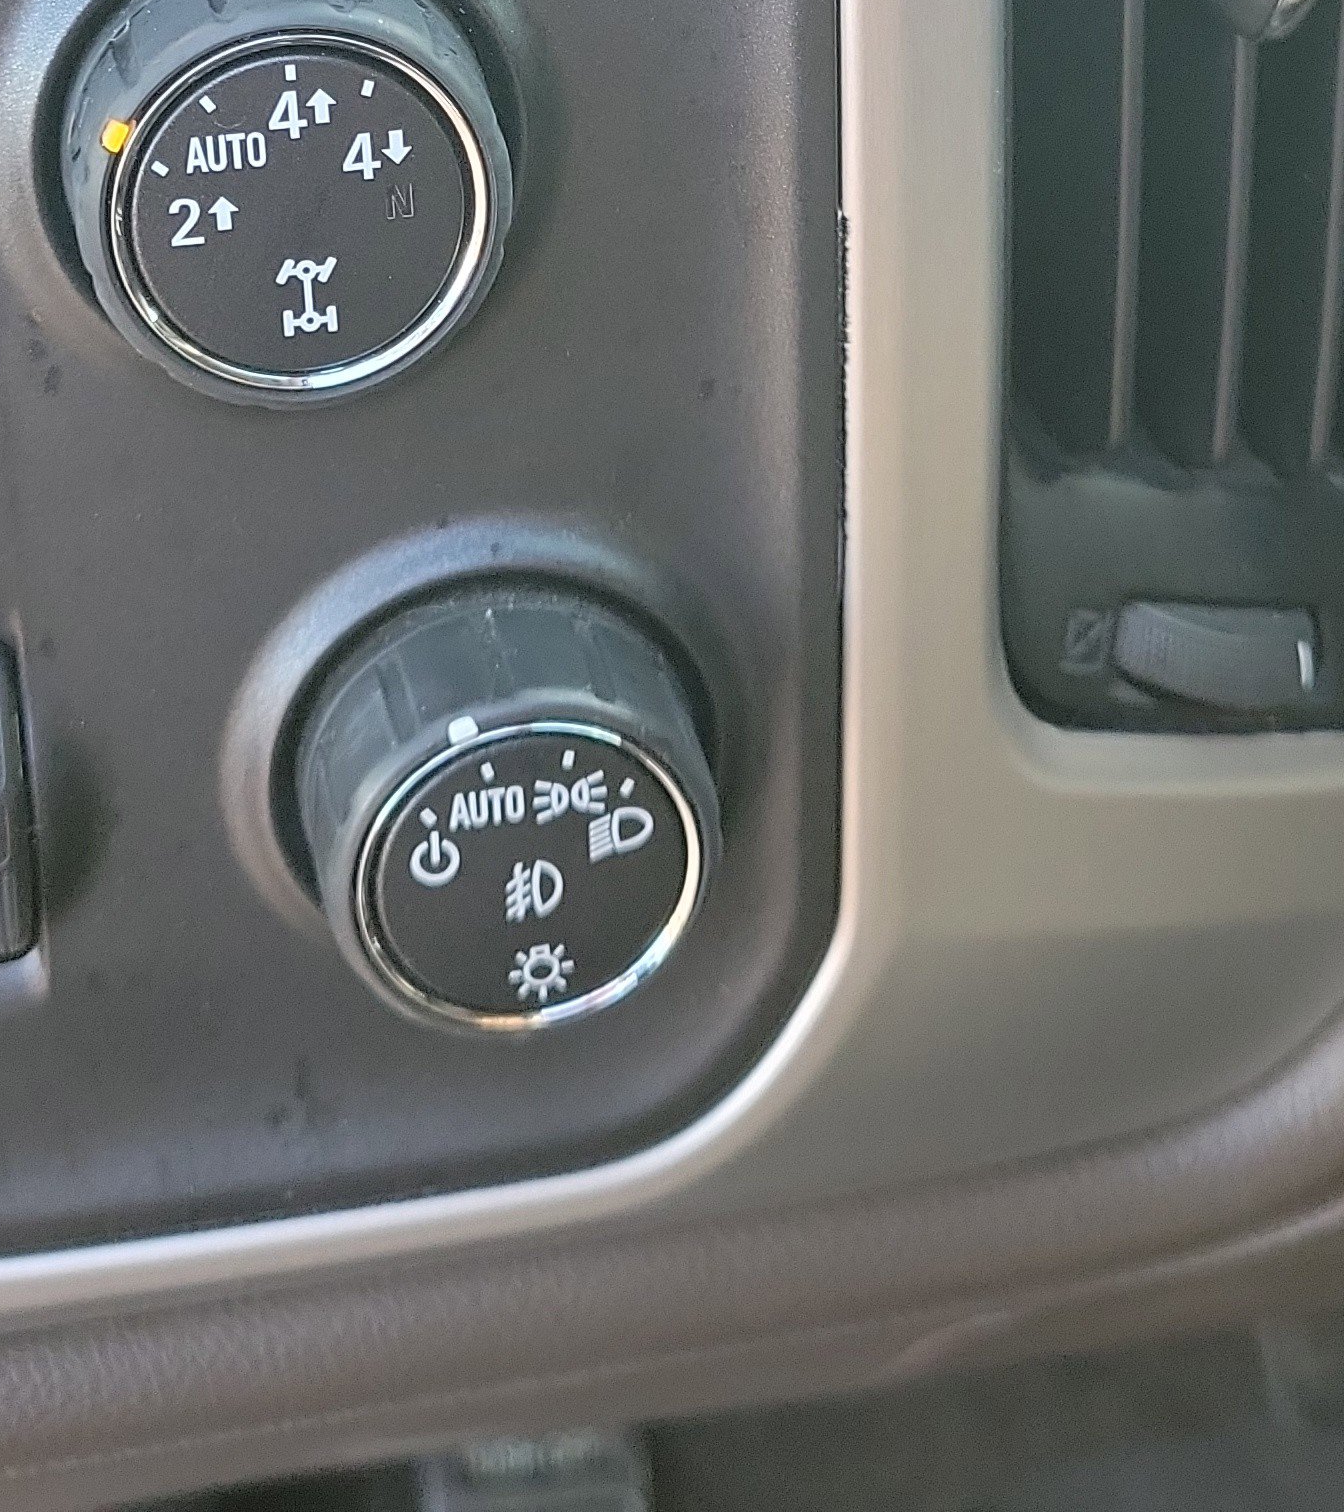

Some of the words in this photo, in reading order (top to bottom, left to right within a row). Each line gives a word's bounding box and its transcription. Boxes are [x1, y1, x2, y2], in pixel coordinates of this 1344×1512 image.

[268, 90, 308, 140] 4
[185, 131, 268, 175] AUTO
[342, 131, 382, 180] 4
[167, 197, 206, 248] 2
[385, 183, 415, 221] N
[447, 784, 527, 832] AUTO
